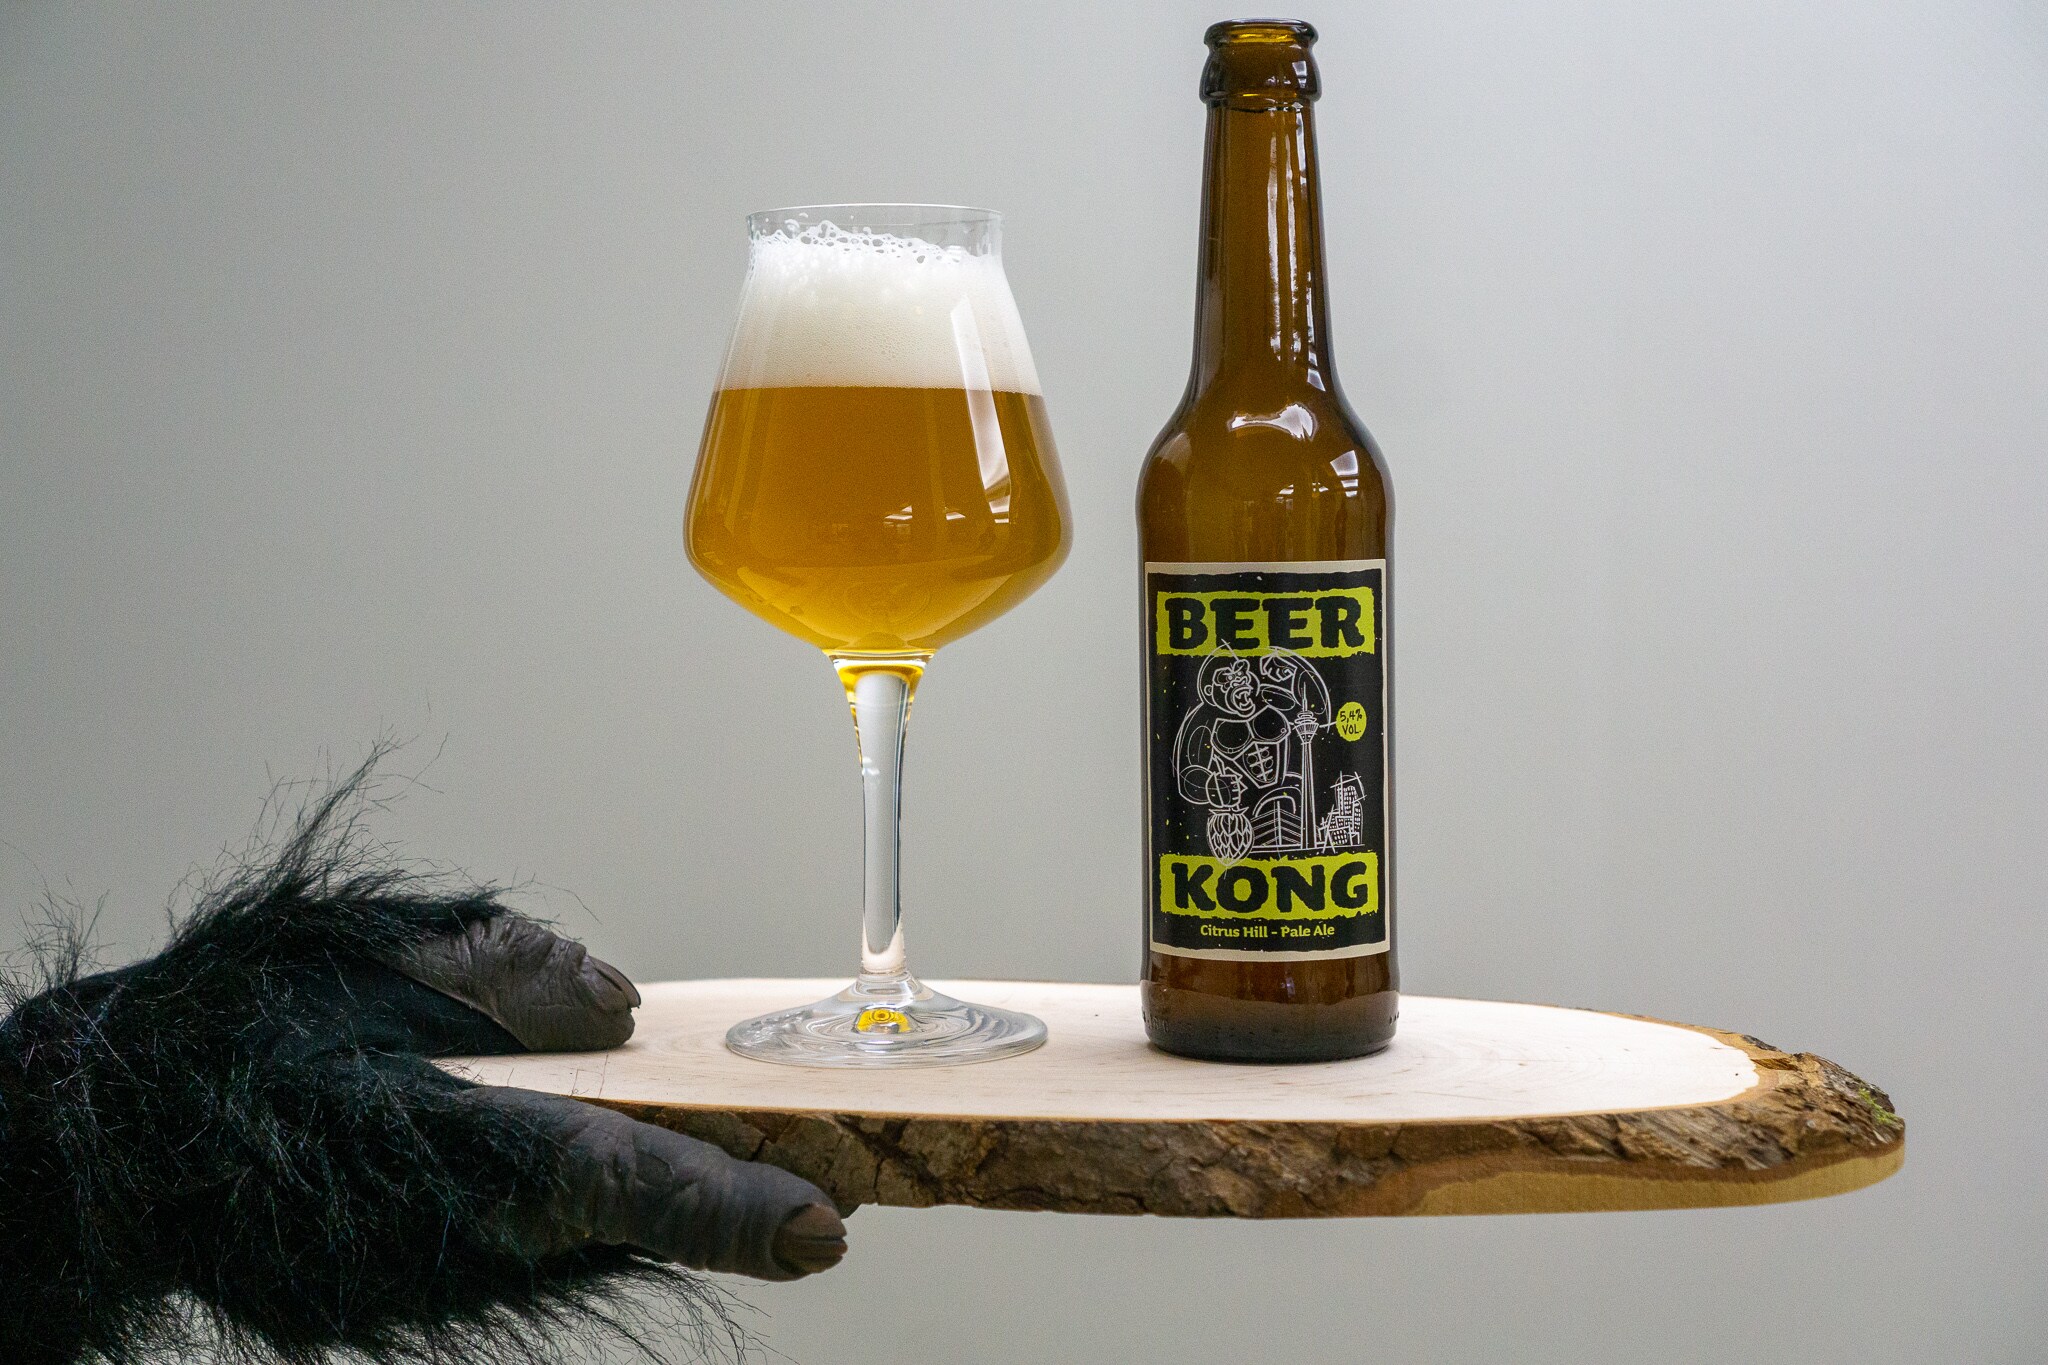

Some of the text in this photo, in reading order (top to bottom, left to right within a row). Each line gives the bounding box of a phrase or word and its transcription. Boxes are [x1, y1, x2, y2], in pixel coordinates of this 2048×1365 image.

[1165, 596, 1365, 650] BEER
[1339, 708, 1363, 723] 5,4%
[1342, 723, 1362, 735] VOL.
[1171, 861, 1369, 913] KONG
[1200, 924, 1240, 938] Citrus
[1242, 925, 1269, 938] Hill
[1280, 925, 1311, 938] Pale
[1313, 923, 1335, 936] Ale
